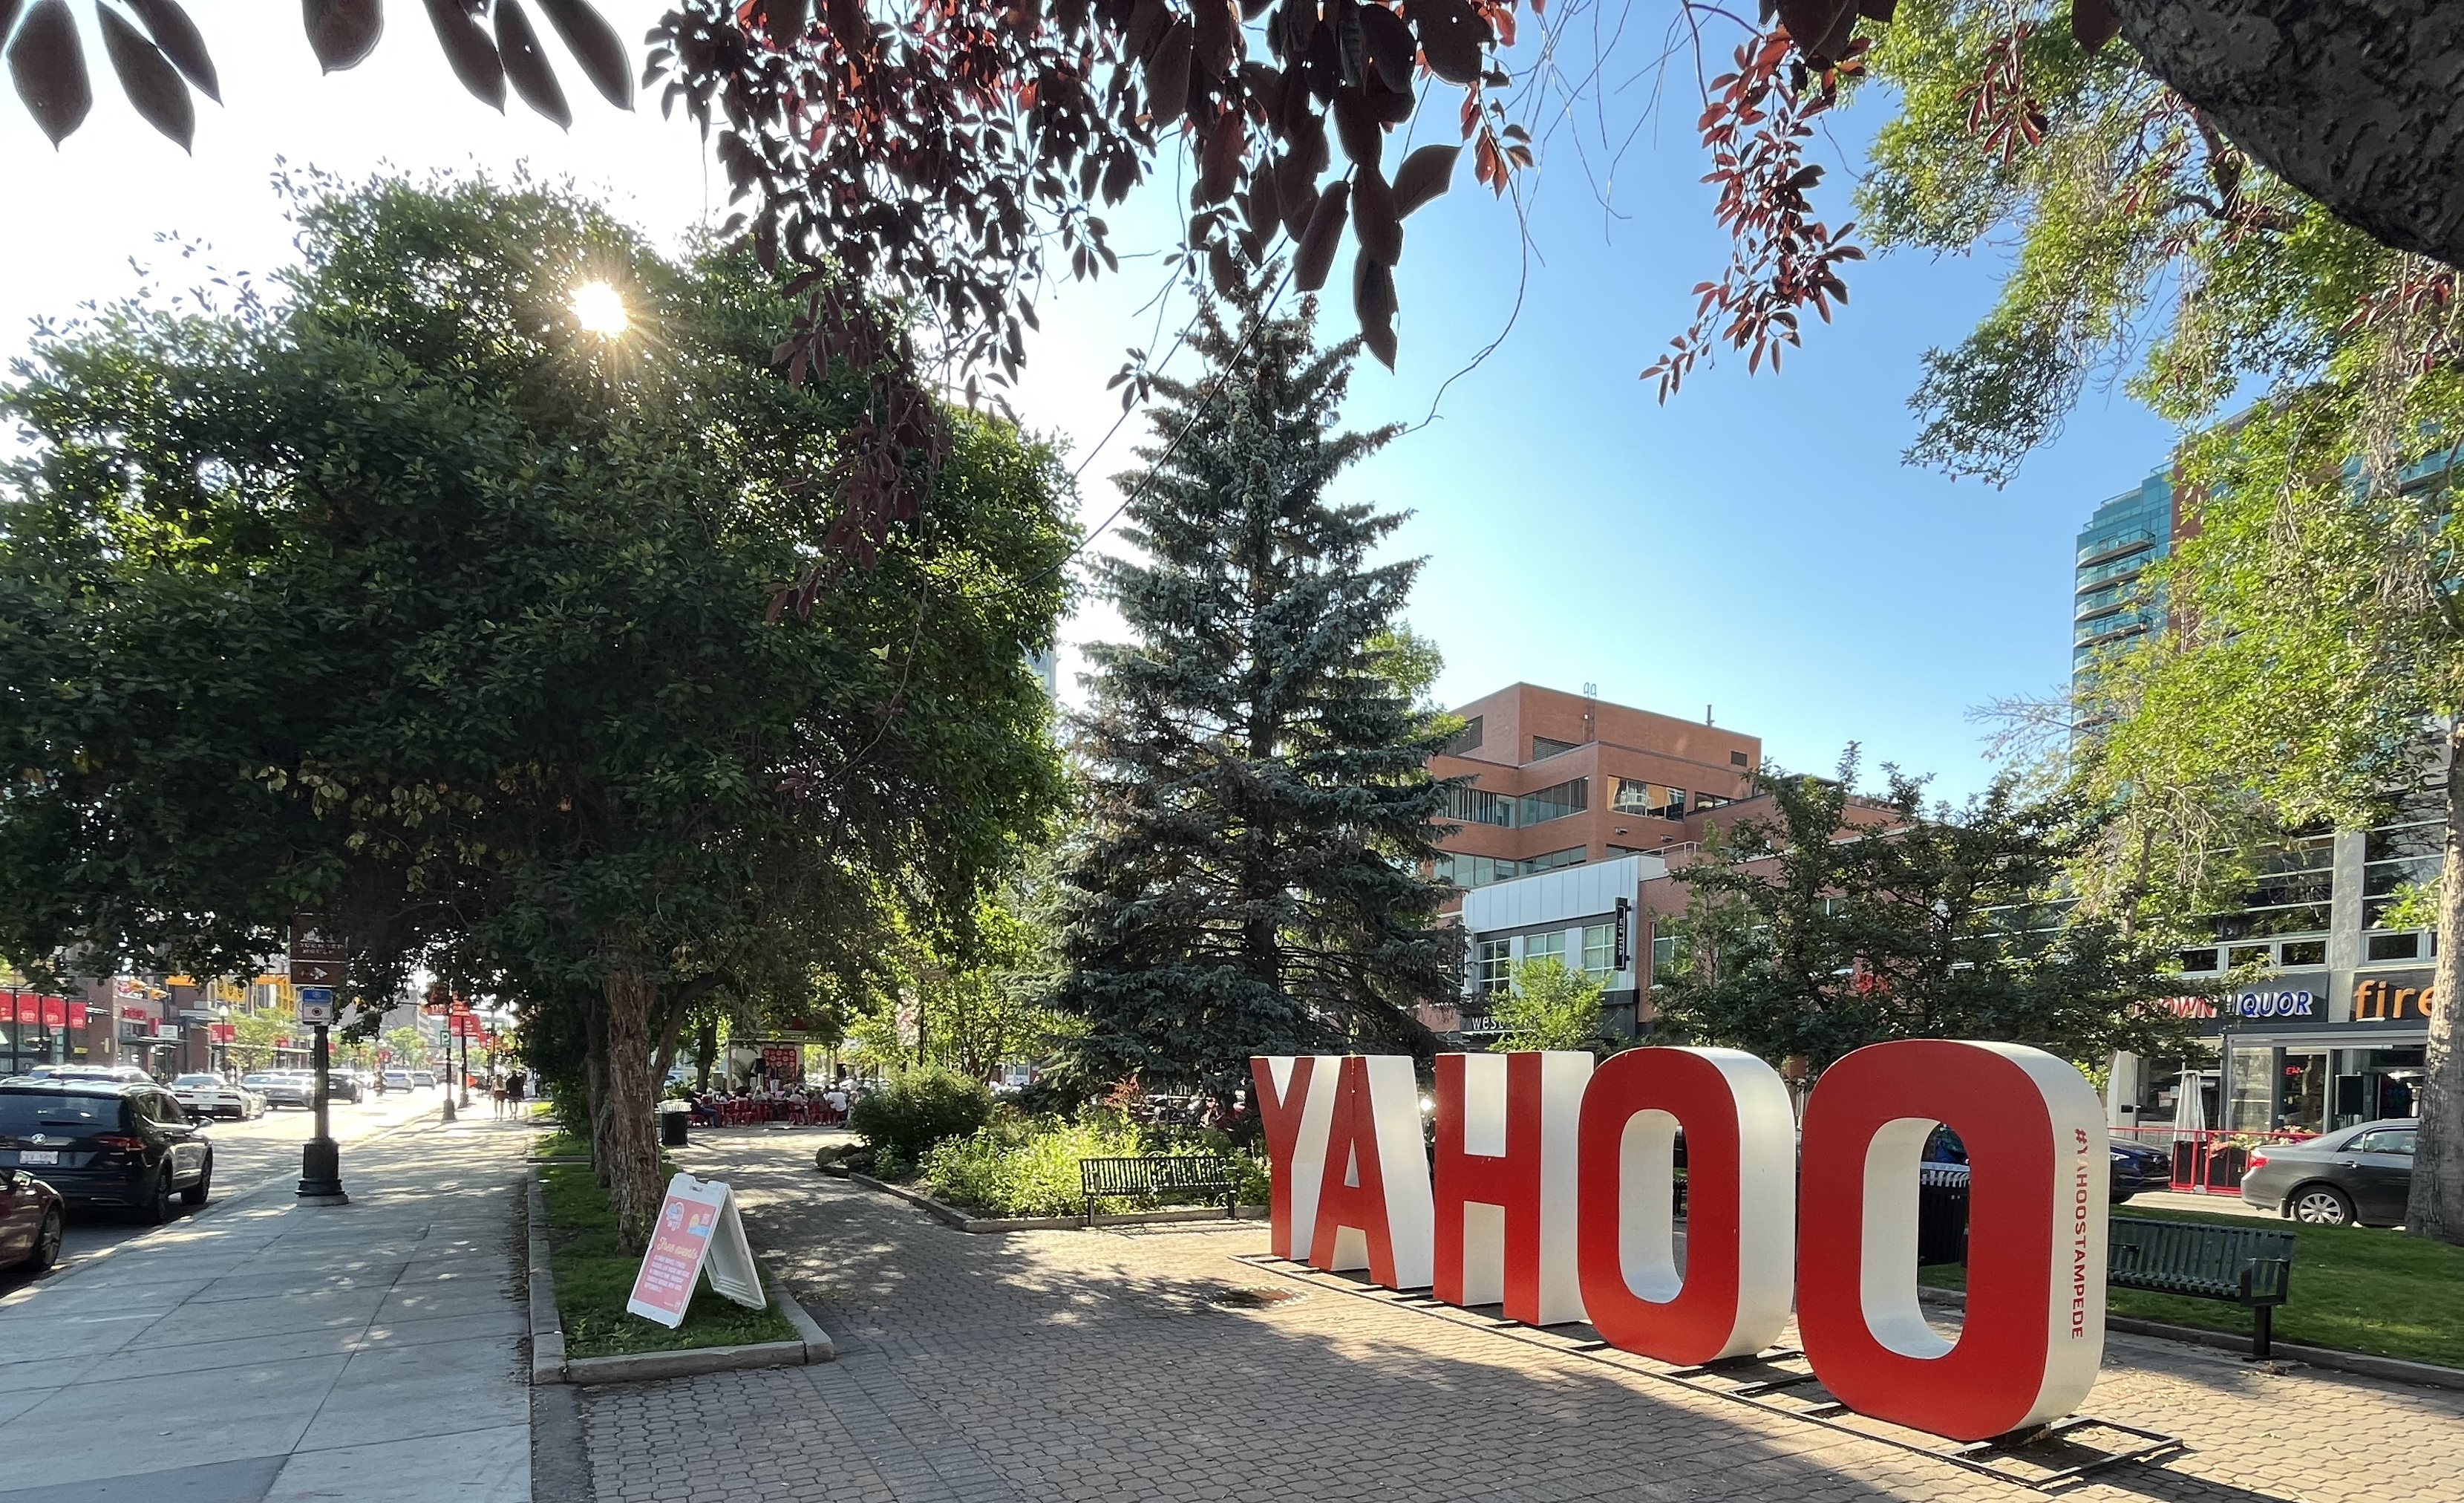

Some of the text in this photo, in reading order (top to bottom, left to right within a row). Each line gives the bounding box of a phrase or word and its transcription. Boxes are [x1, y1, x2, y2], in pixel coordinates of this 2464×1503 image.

[2134, 991, 2313, 1019] OWN IQUOR
[1250, 1040, 2071, 1441] YAHOO
[2071, 1127, 2089, 1340] #YAHOOSTAMPEDE
